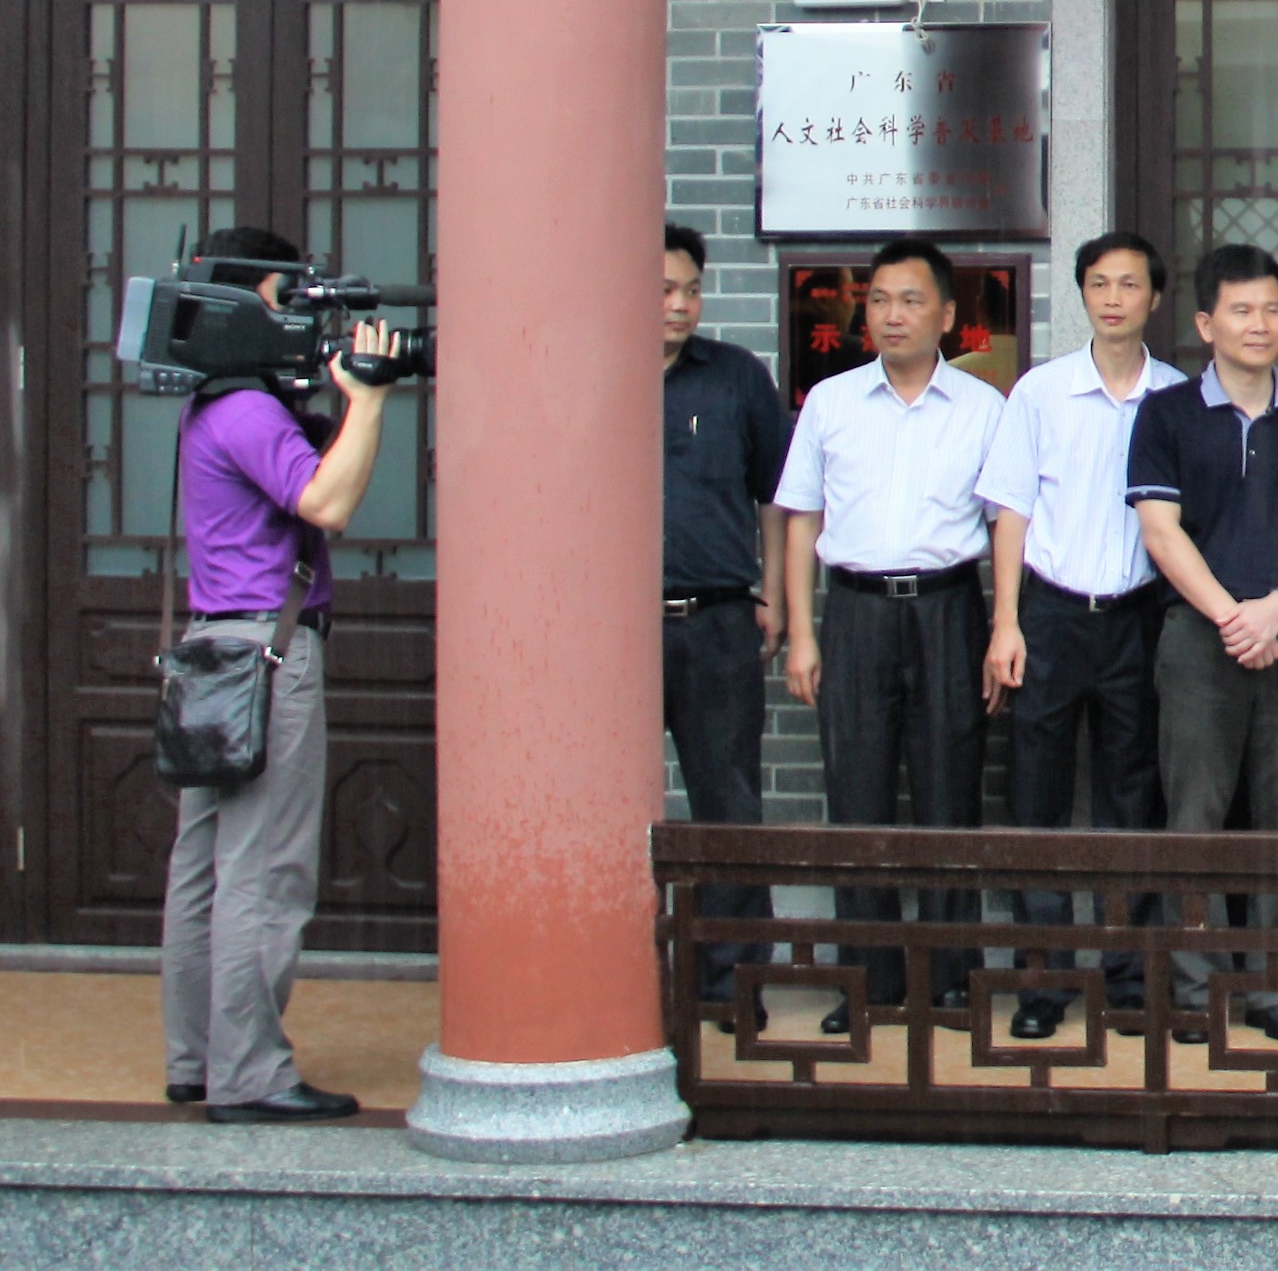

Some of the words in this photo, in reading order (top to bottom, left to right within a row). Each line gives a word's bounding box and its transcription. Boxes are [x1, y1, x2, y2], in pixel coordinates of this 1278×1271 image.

[849, 70, 956, 92] 广东省
[771, 114, 1034, 147] 人文社会科学普及基地
